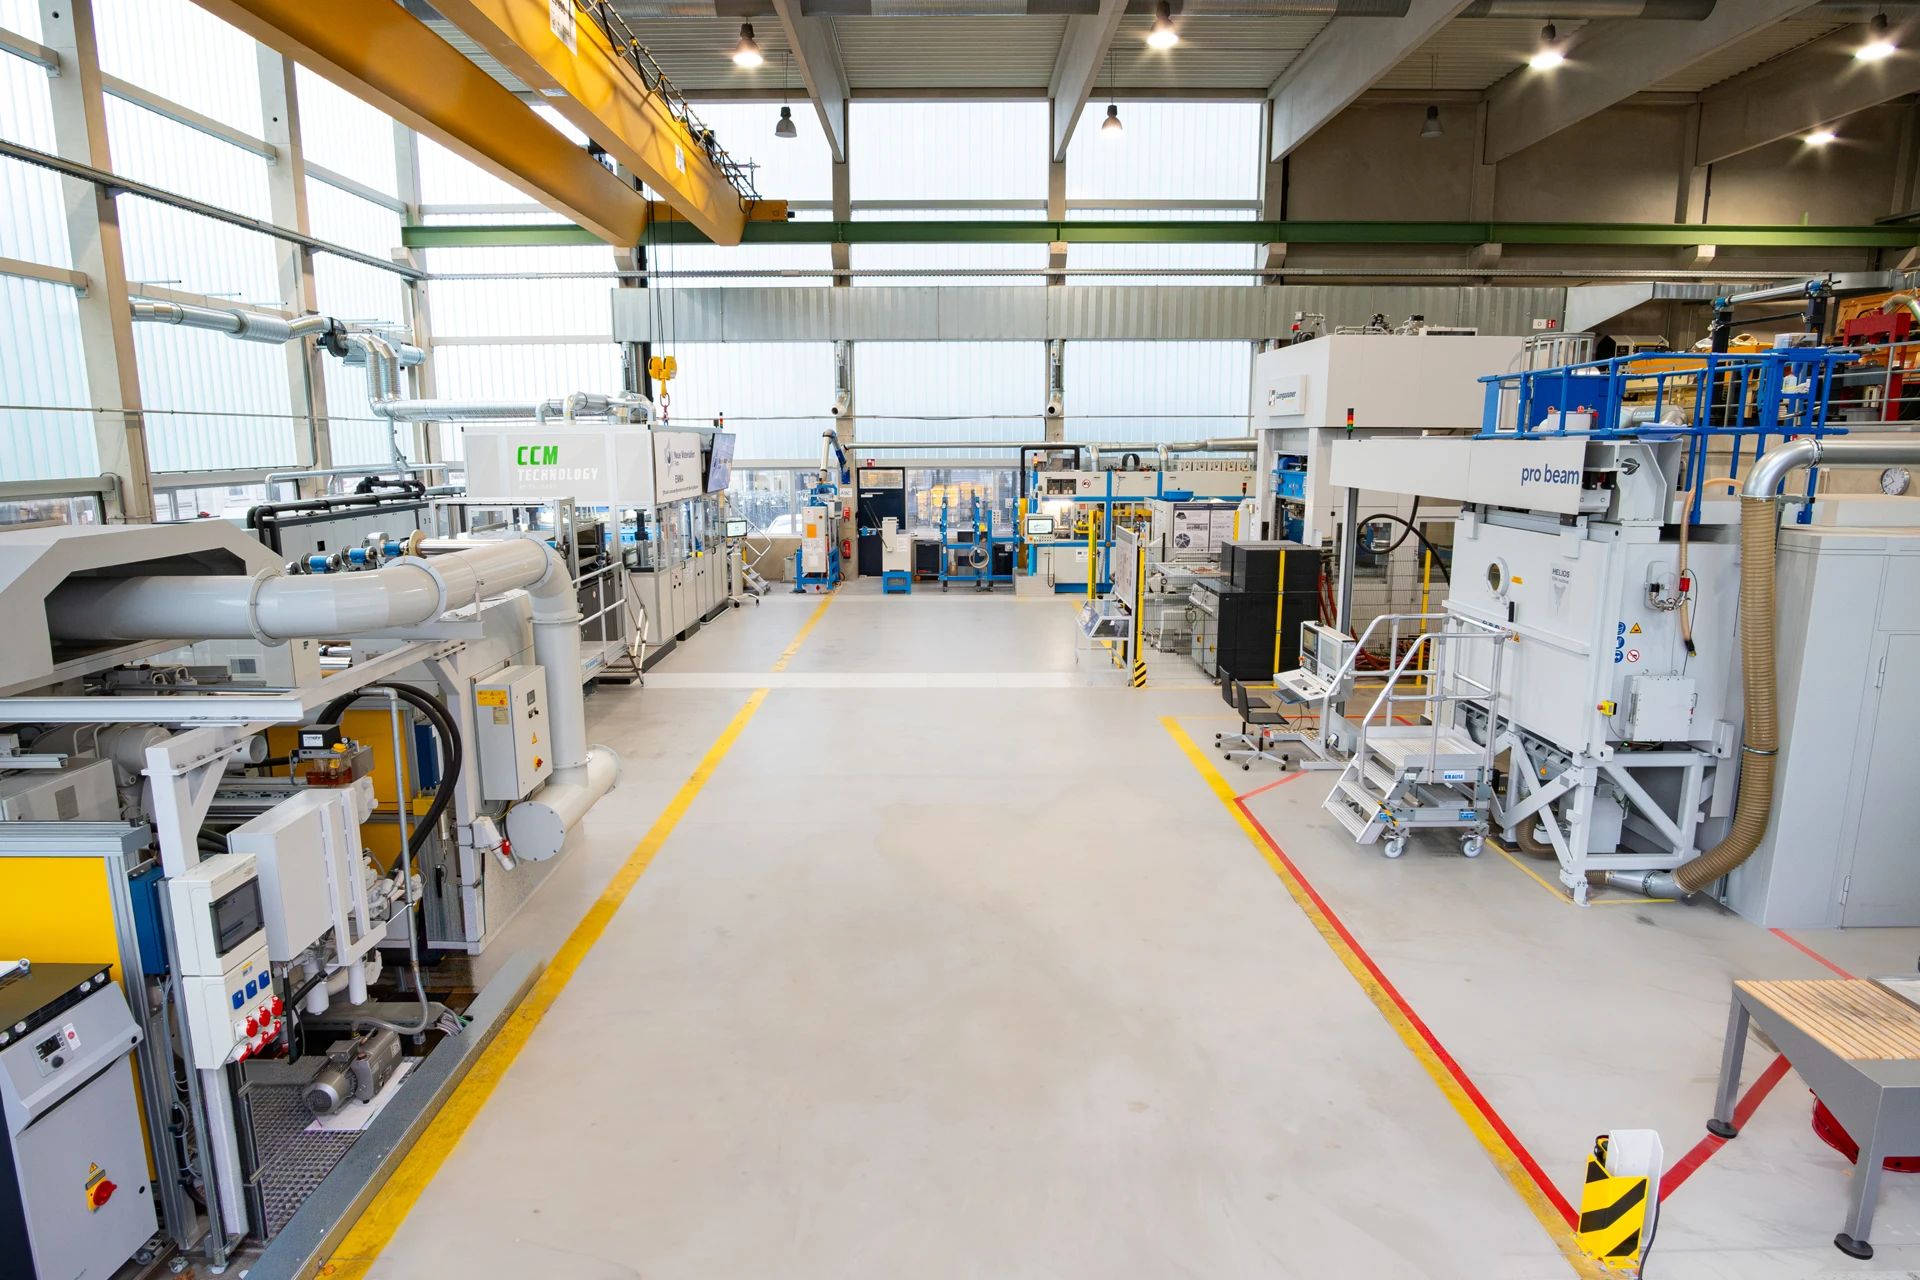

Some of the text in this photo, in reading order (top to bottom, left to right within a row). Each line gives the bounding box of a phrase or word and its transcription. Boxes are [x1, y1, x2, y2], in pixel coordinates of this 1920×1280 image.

[517, 445, 559, 466] CCM
[517, 467, 599, 481] TECHNOLOGY
[1521, 463, 1580, 487] pro beam
[1551, 567, 1570, 579] HELIOS
